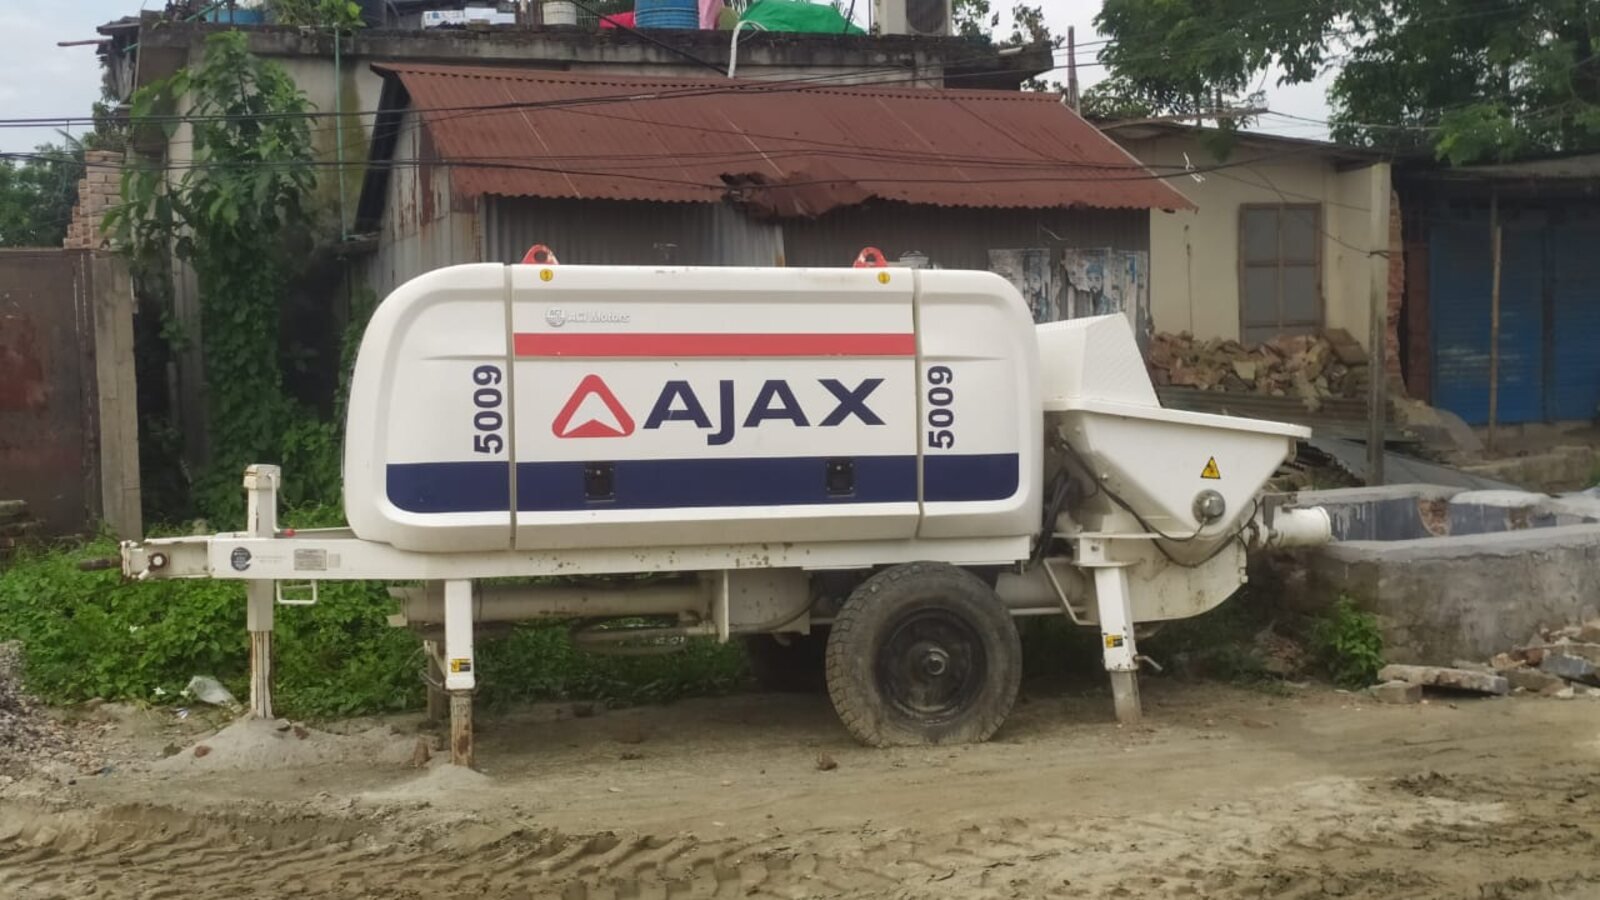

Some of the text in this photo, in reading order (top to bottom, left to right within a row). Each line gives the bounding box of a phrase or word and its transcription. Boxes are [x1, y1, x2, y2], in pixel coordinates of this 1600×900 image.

[473, 365, 503, 454] 5009
[643, 378, 885, 445] AJAX
[928, 366, 954, 449] 5009
